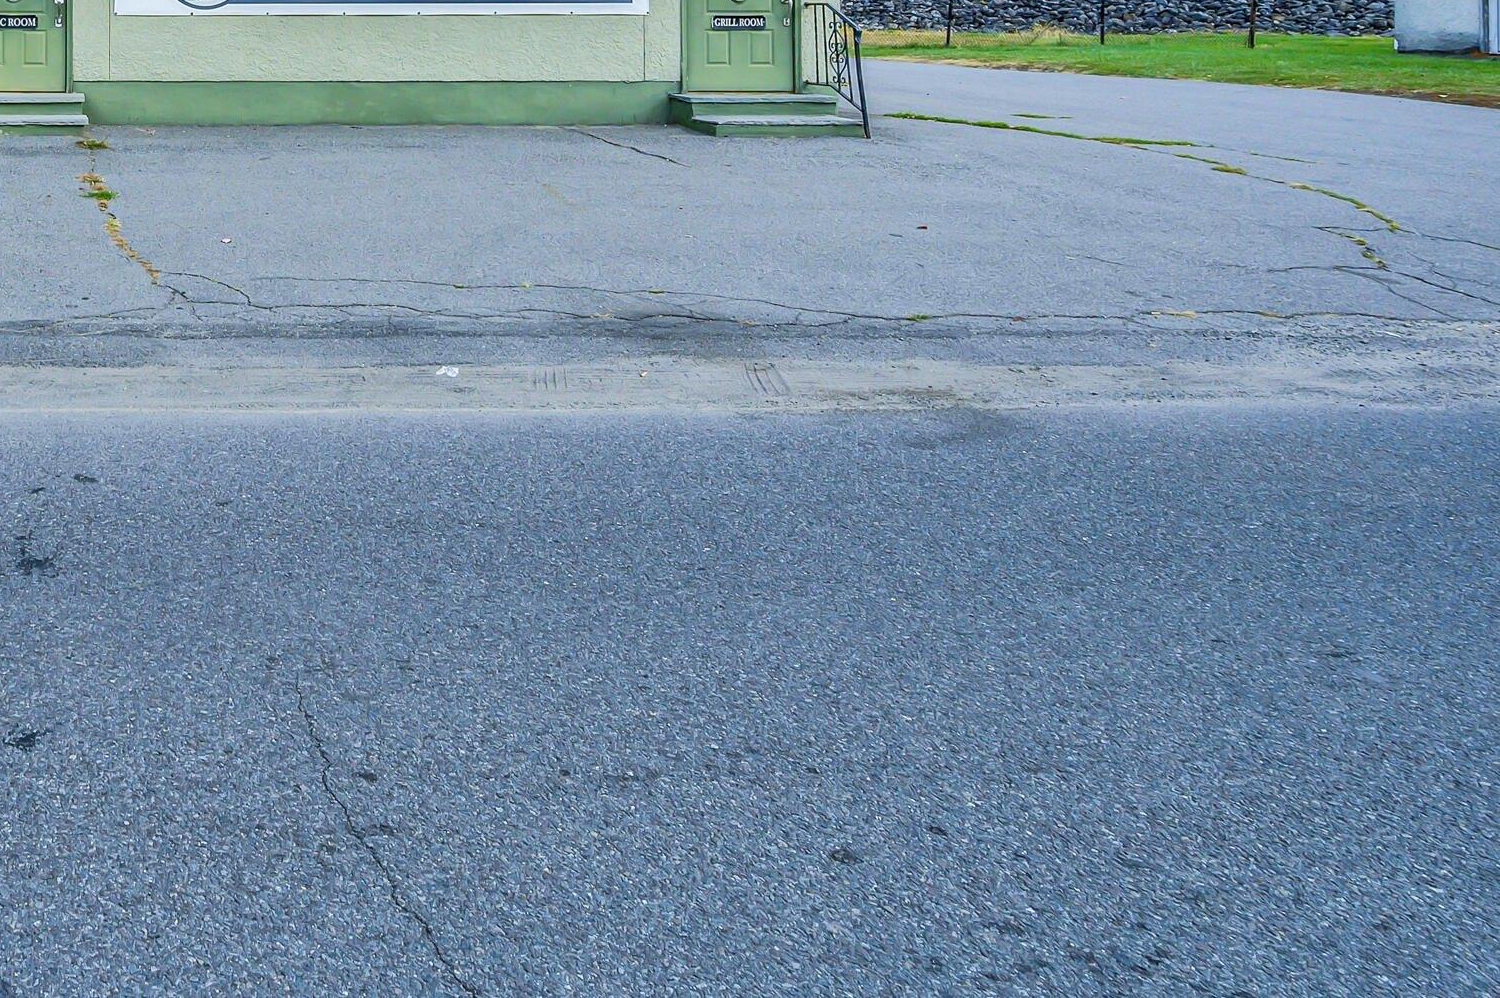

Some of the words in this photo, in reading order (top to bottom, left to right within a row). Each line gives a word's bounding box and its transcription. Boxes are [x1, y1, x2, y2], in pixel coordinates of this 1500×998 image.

[7, 17, 36, 27] ROOM
[714, 18, 738, 27] GRILL
[739, 18, 764, 27] ROOM
